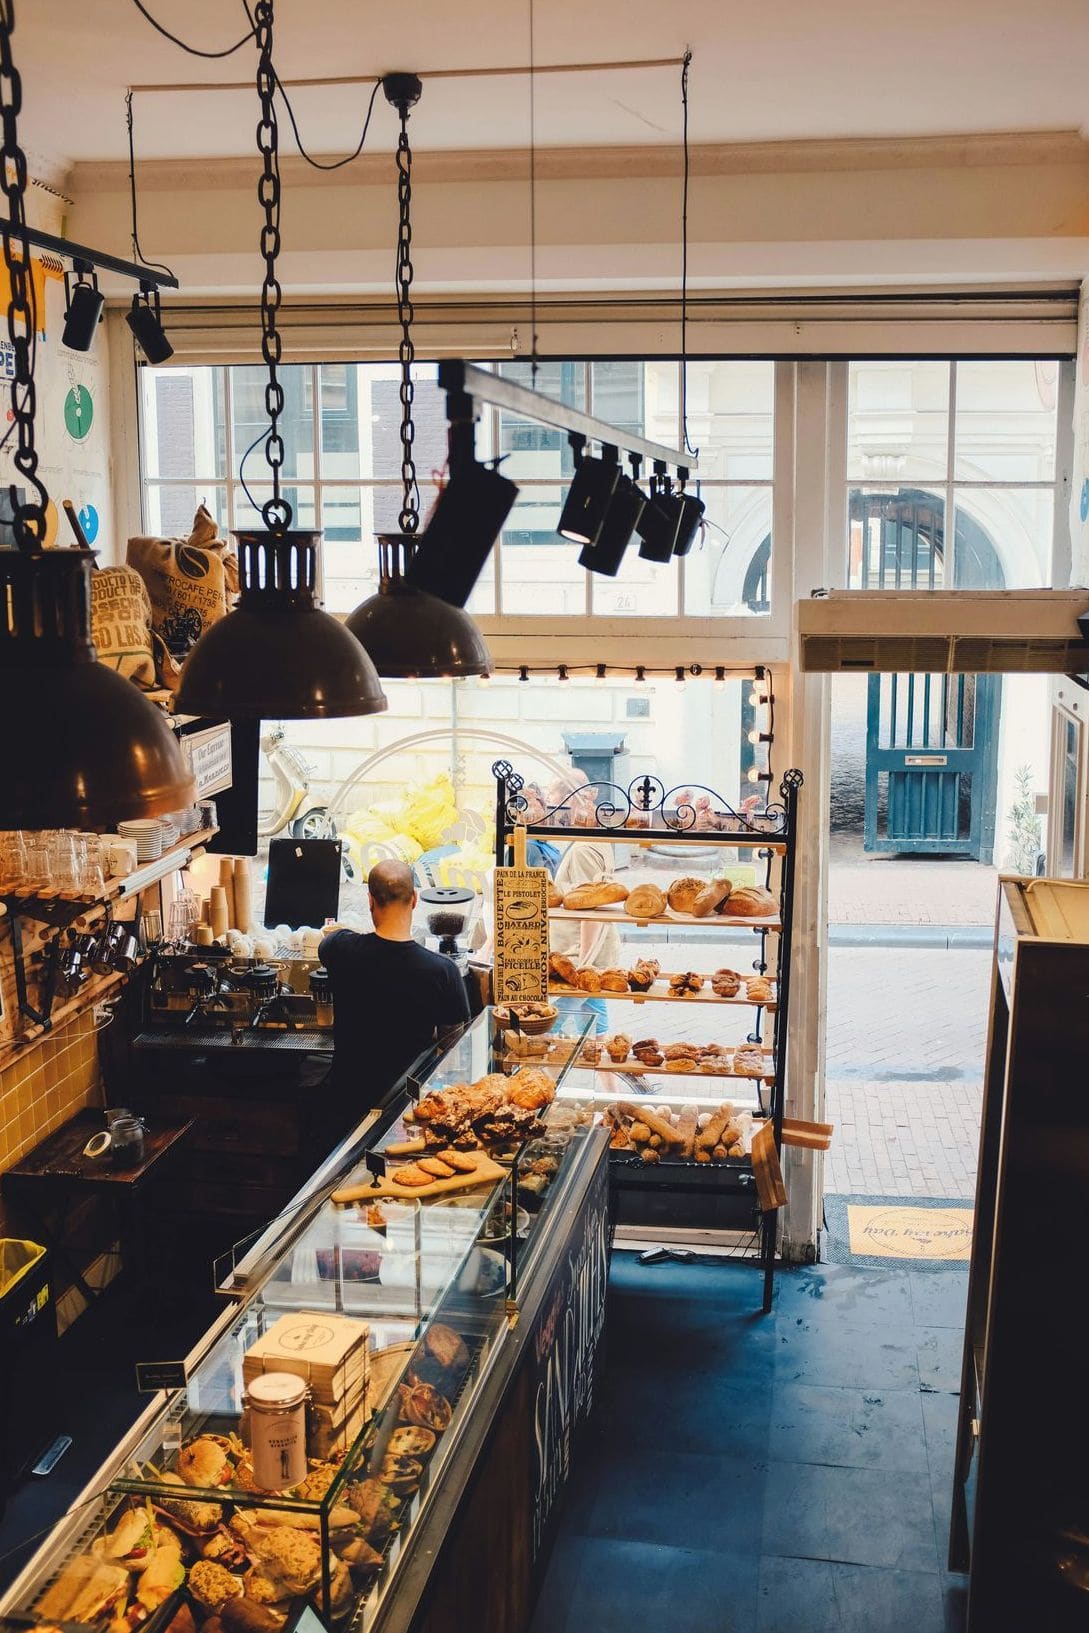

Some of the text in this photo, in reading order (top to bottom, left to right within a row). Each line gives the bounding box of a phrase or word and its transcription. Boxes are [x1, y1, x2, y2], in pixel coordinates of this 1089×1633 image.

[496, 870, 546, 879] PAIN DE LA FRANCE
[512, 890, 541, 898] PISTOLET
[496, 879, 504, 947] BAGUETTE
[497, 953, 504, 969] LA
[505, 962, 541, 970] FICELLE
[519, 994, 547, 1002] CHOCOLAT
